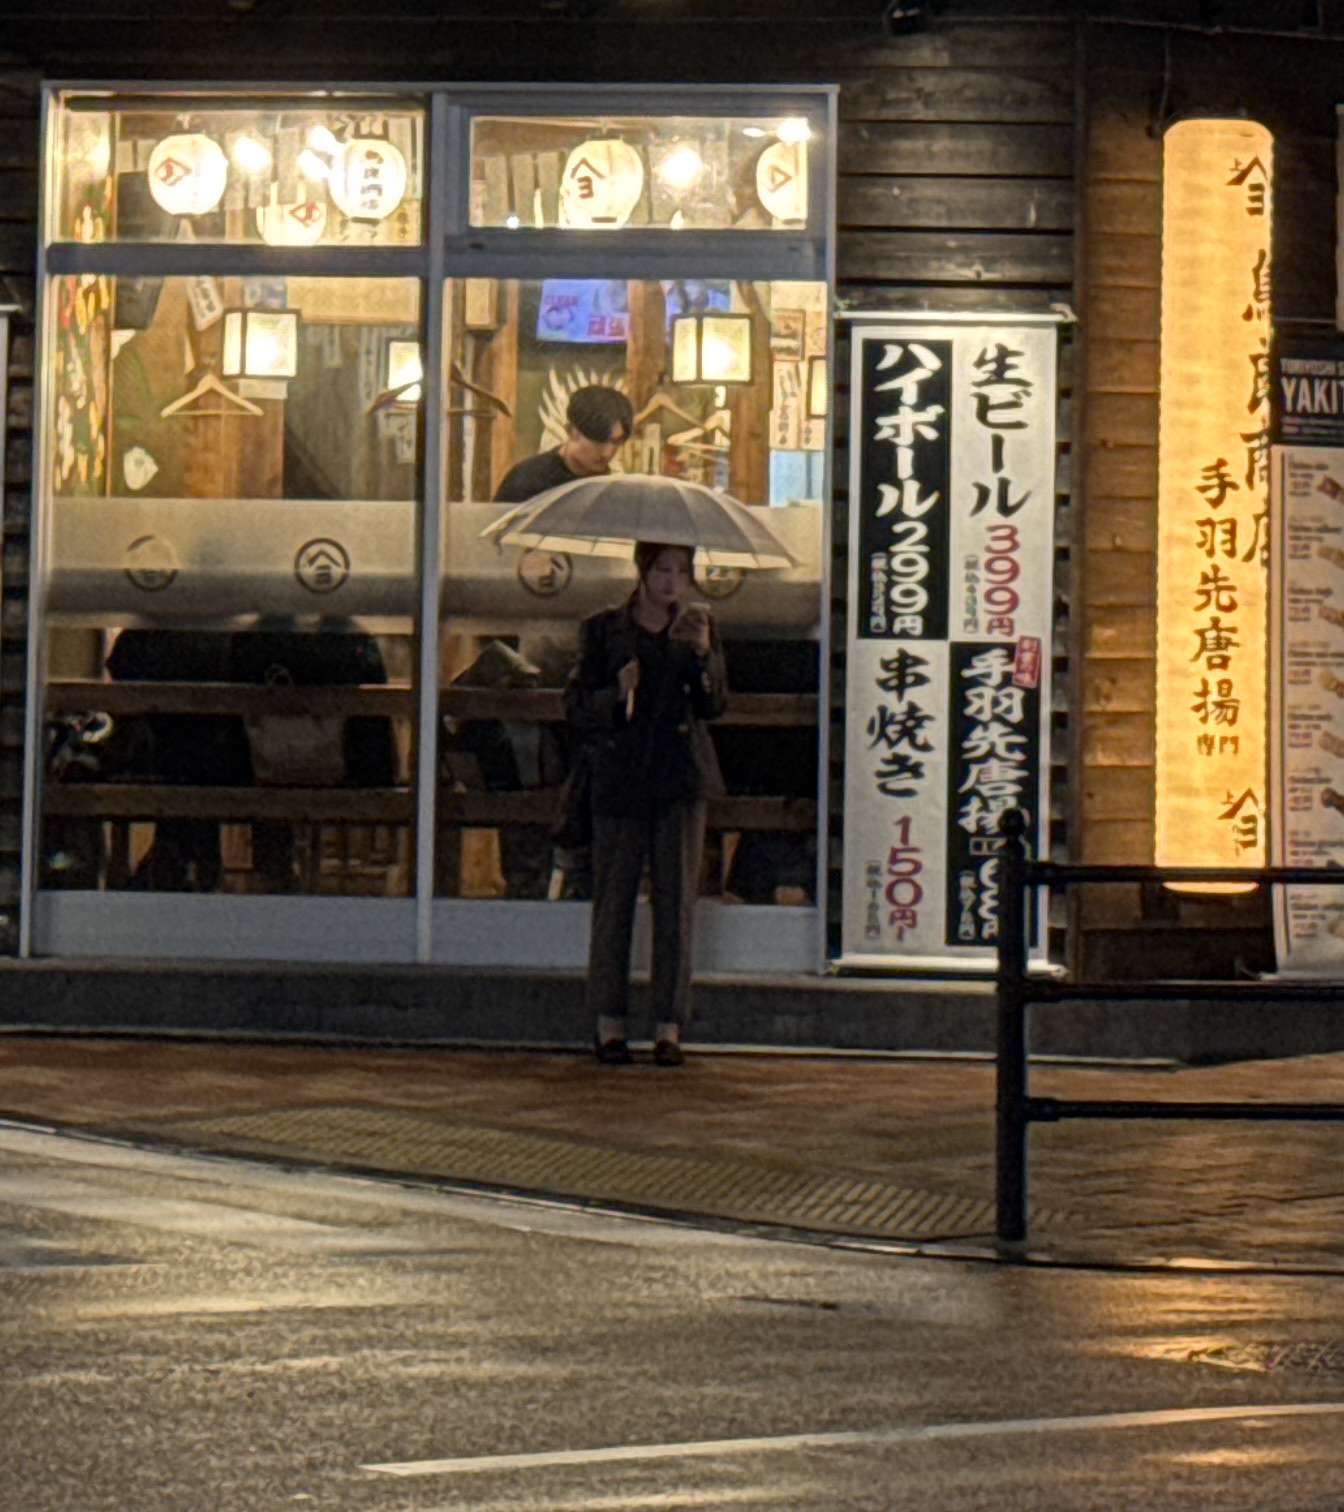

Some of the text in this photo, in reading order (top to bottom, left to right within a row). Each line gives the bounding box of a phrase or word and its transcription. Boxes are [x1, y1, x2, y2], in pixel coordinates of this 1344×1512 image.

[873, 343, 946, 519] ハイボール
[968, 342, 1035, 519] 生ビール
[1189, 456, 1243, 728] 手羽先唐揚
[865, 646, 936, 799] 串焼き
